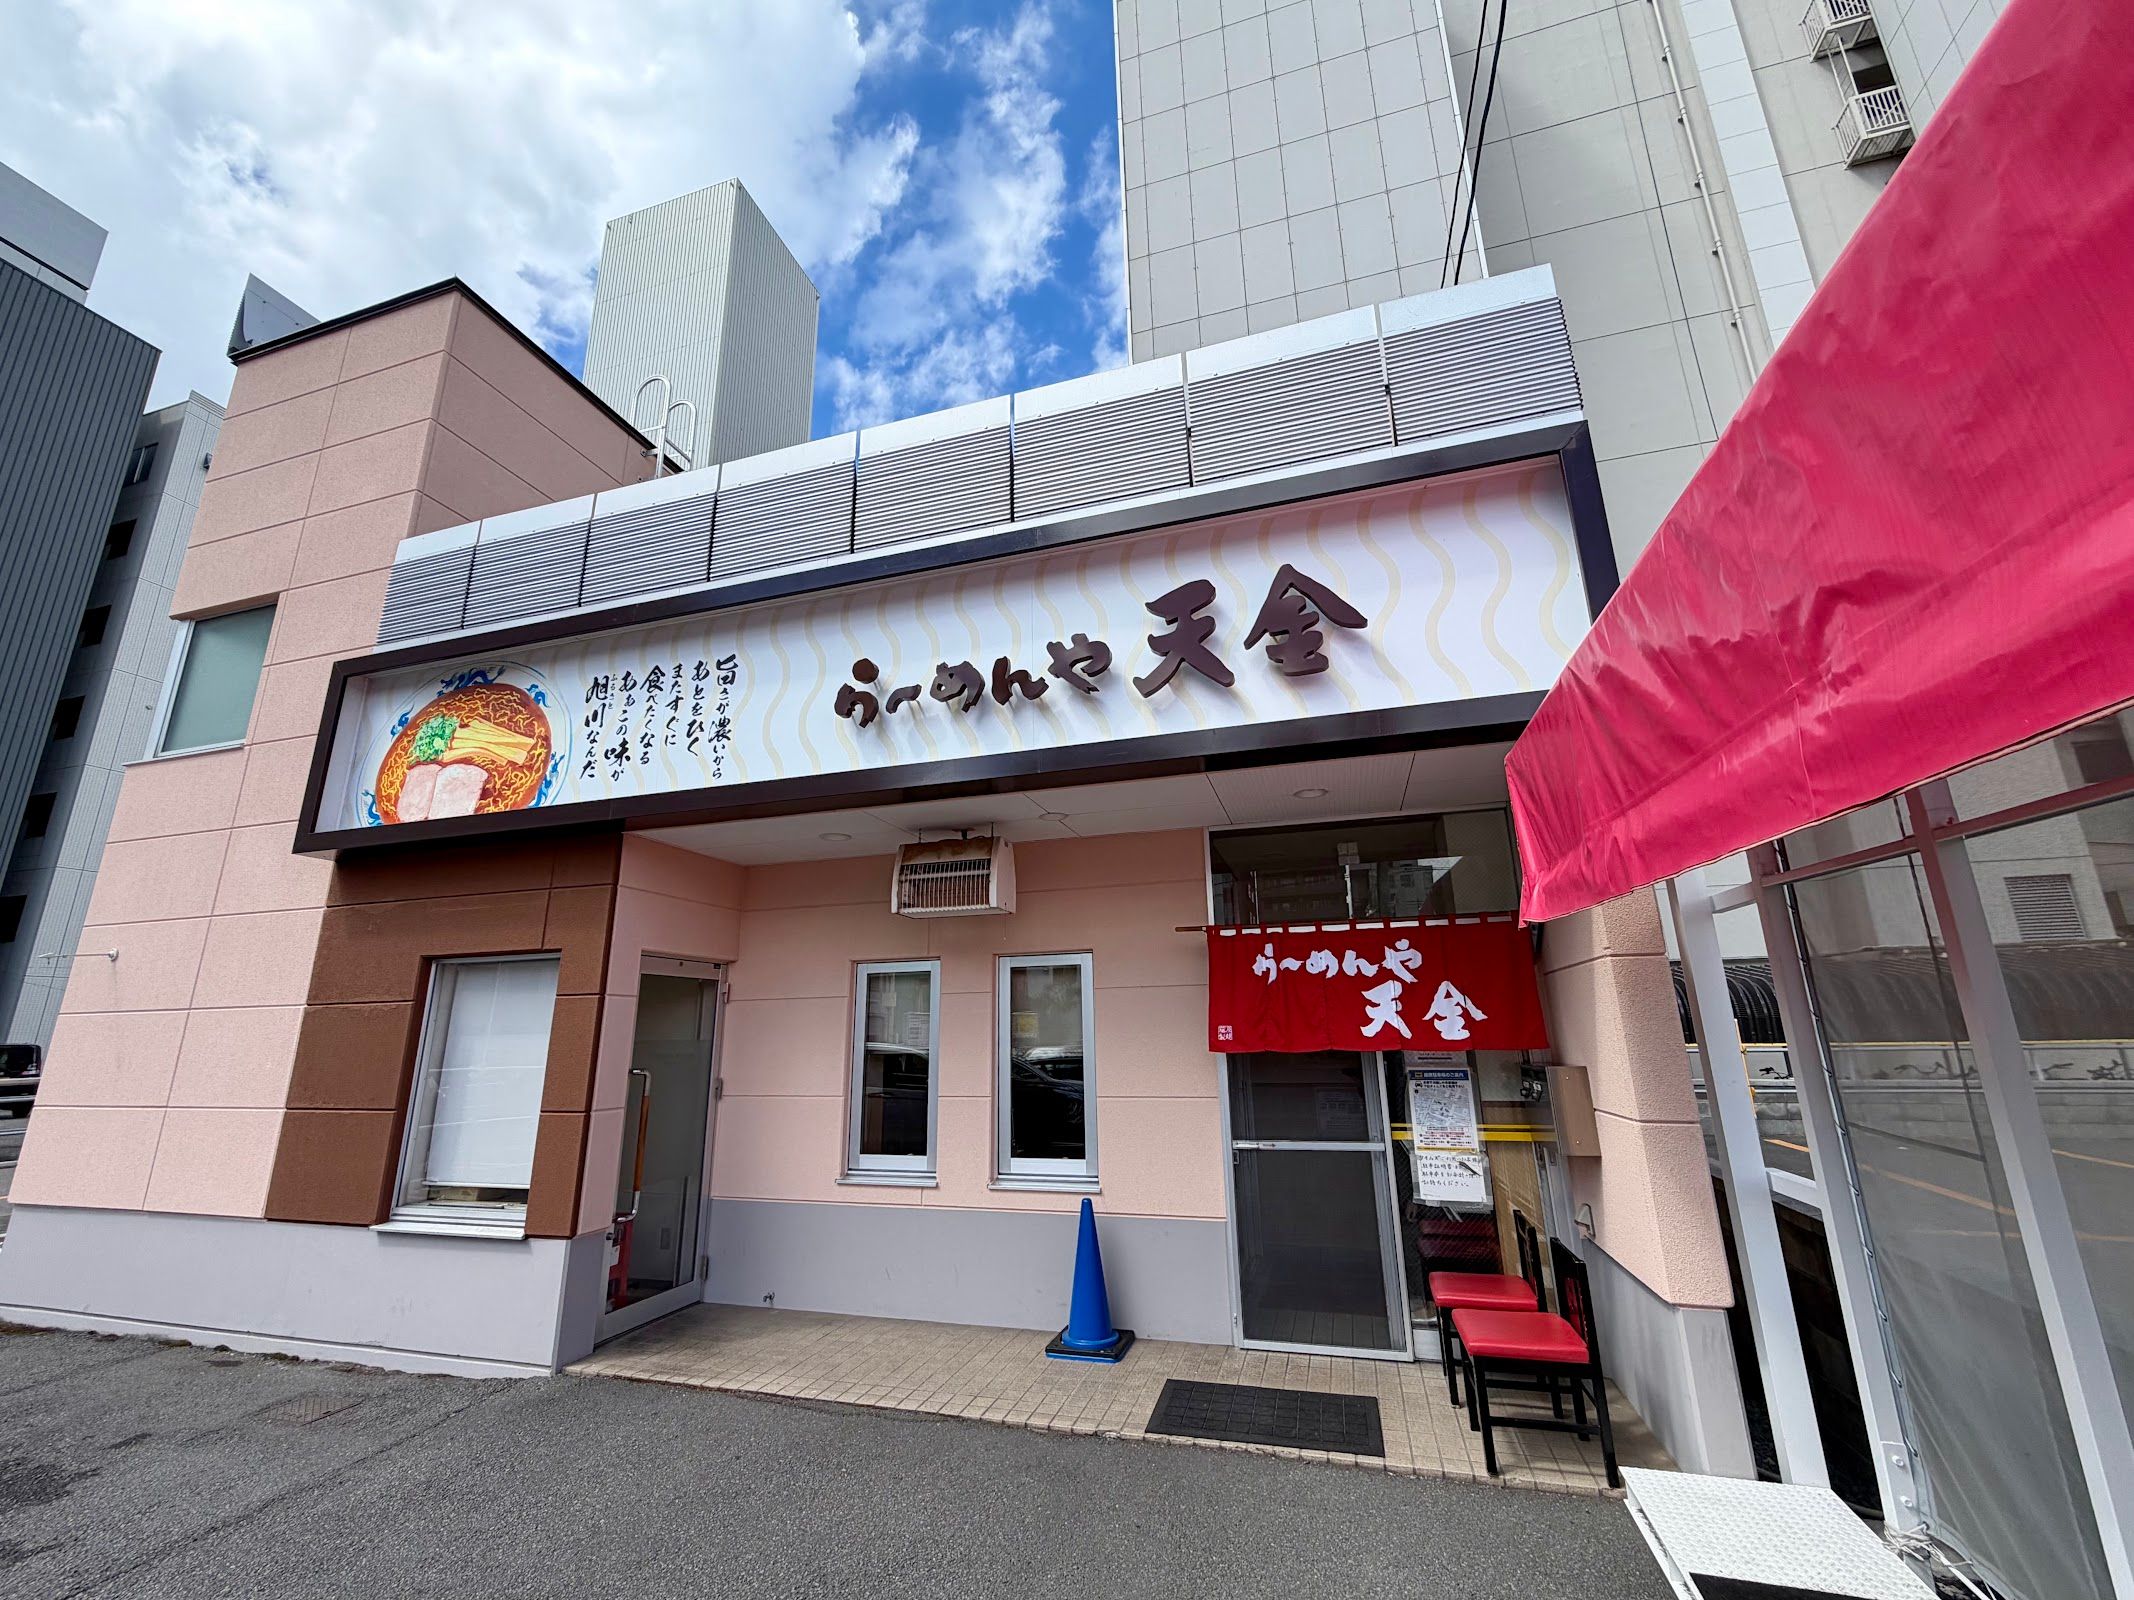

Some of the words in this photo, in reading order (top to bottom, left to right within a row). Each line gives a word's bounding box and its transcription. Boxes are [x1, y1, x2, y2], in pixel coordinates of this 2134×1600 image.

[833, 632, 1113, 729] らーめんや
[1132, 563, 1368, 698] 天金
[580, 675, 610, 779] 旭川なんだ
[603, 670, 638, 782] ああこの味が
[640, 665, 666, 765] 食べたくなる
[665, 662, 684, 747] またすぐに
[686, 660, 710, 757] あとをひく
[708, 653, 739, 780] 旨さが濃いから
[1251, 938, 1423, 986] らーめんや
[1359, 979, 1489, 1041] 天金
